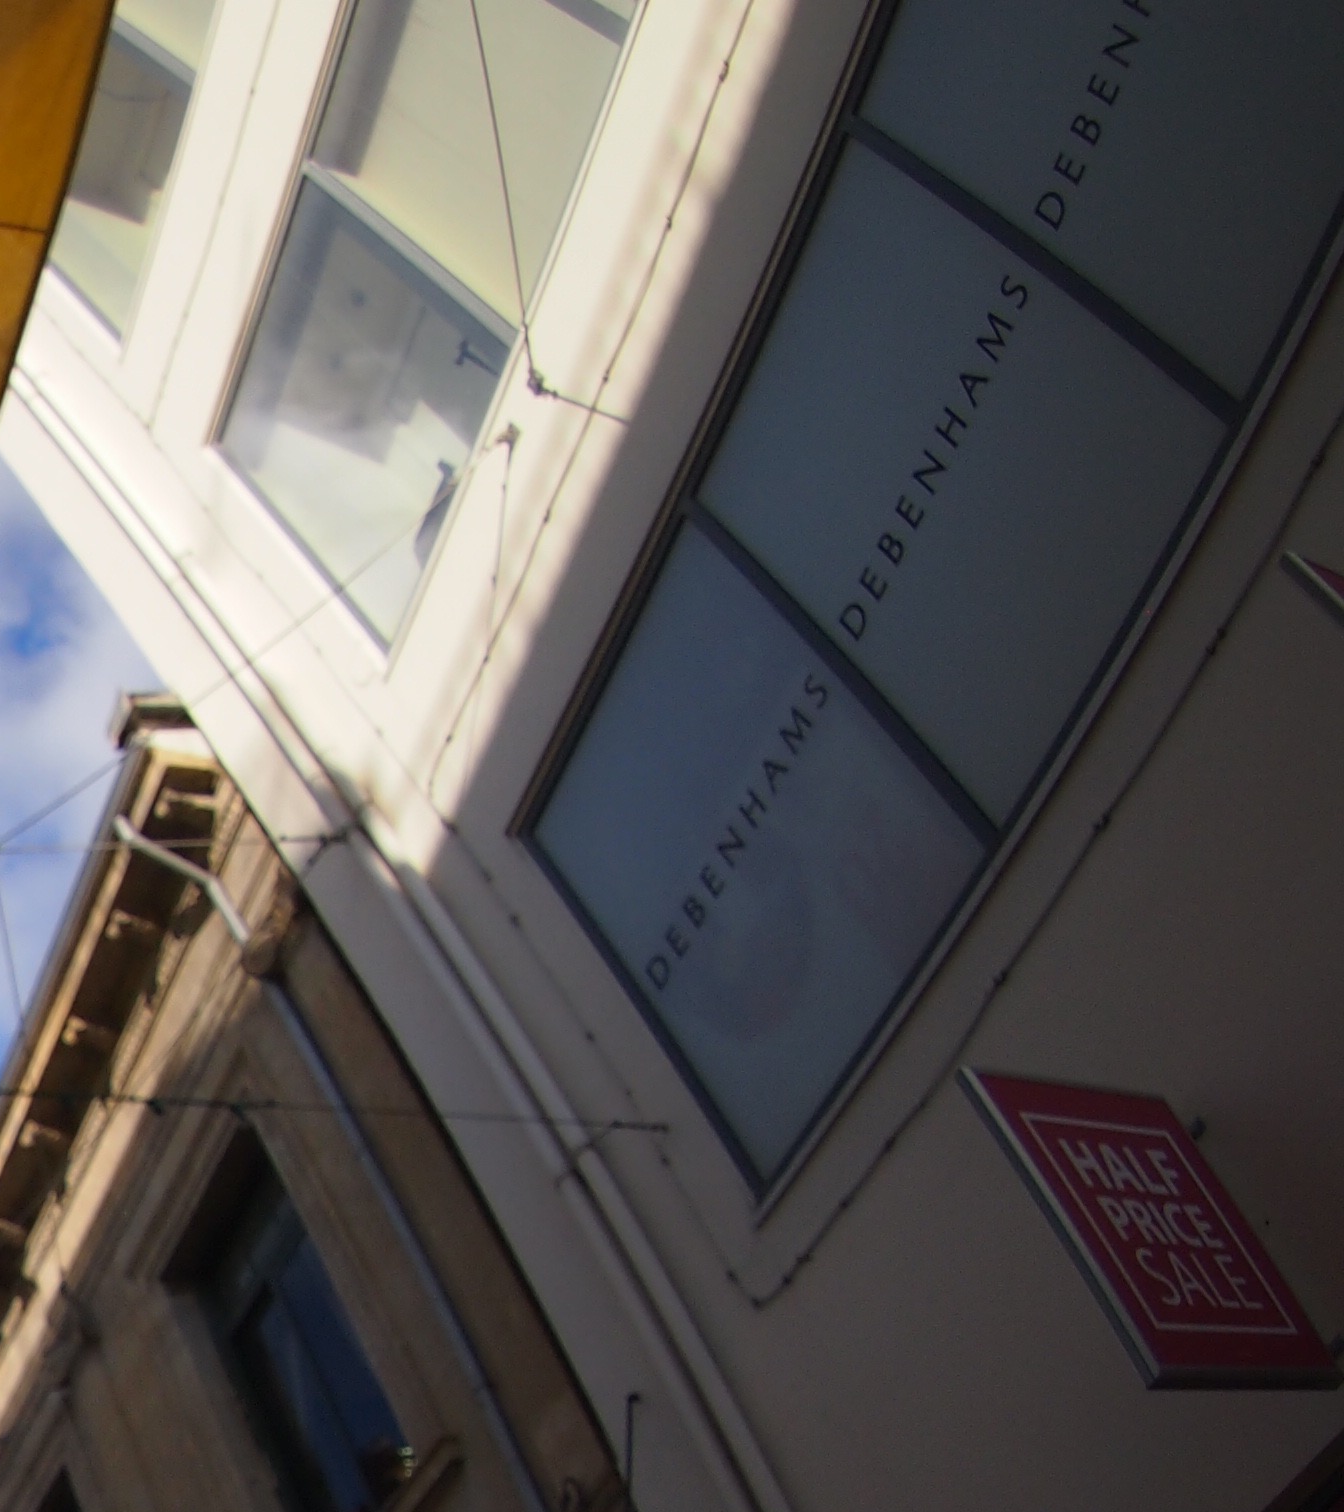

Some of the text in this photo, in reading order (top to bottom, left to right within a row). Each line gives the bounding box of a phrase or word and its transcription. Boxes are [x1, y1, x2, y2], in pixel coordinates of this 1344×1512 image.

[838, 273, 1029, 641] DEBENHAMS
[645, 672, 828, 991] DEBENHAMS
[1058, 1137, 1180, 1197] HALF
[1095, 1195, 1226, 1249] PRICE
[1135, 1247, 1264, 1310] SALE
